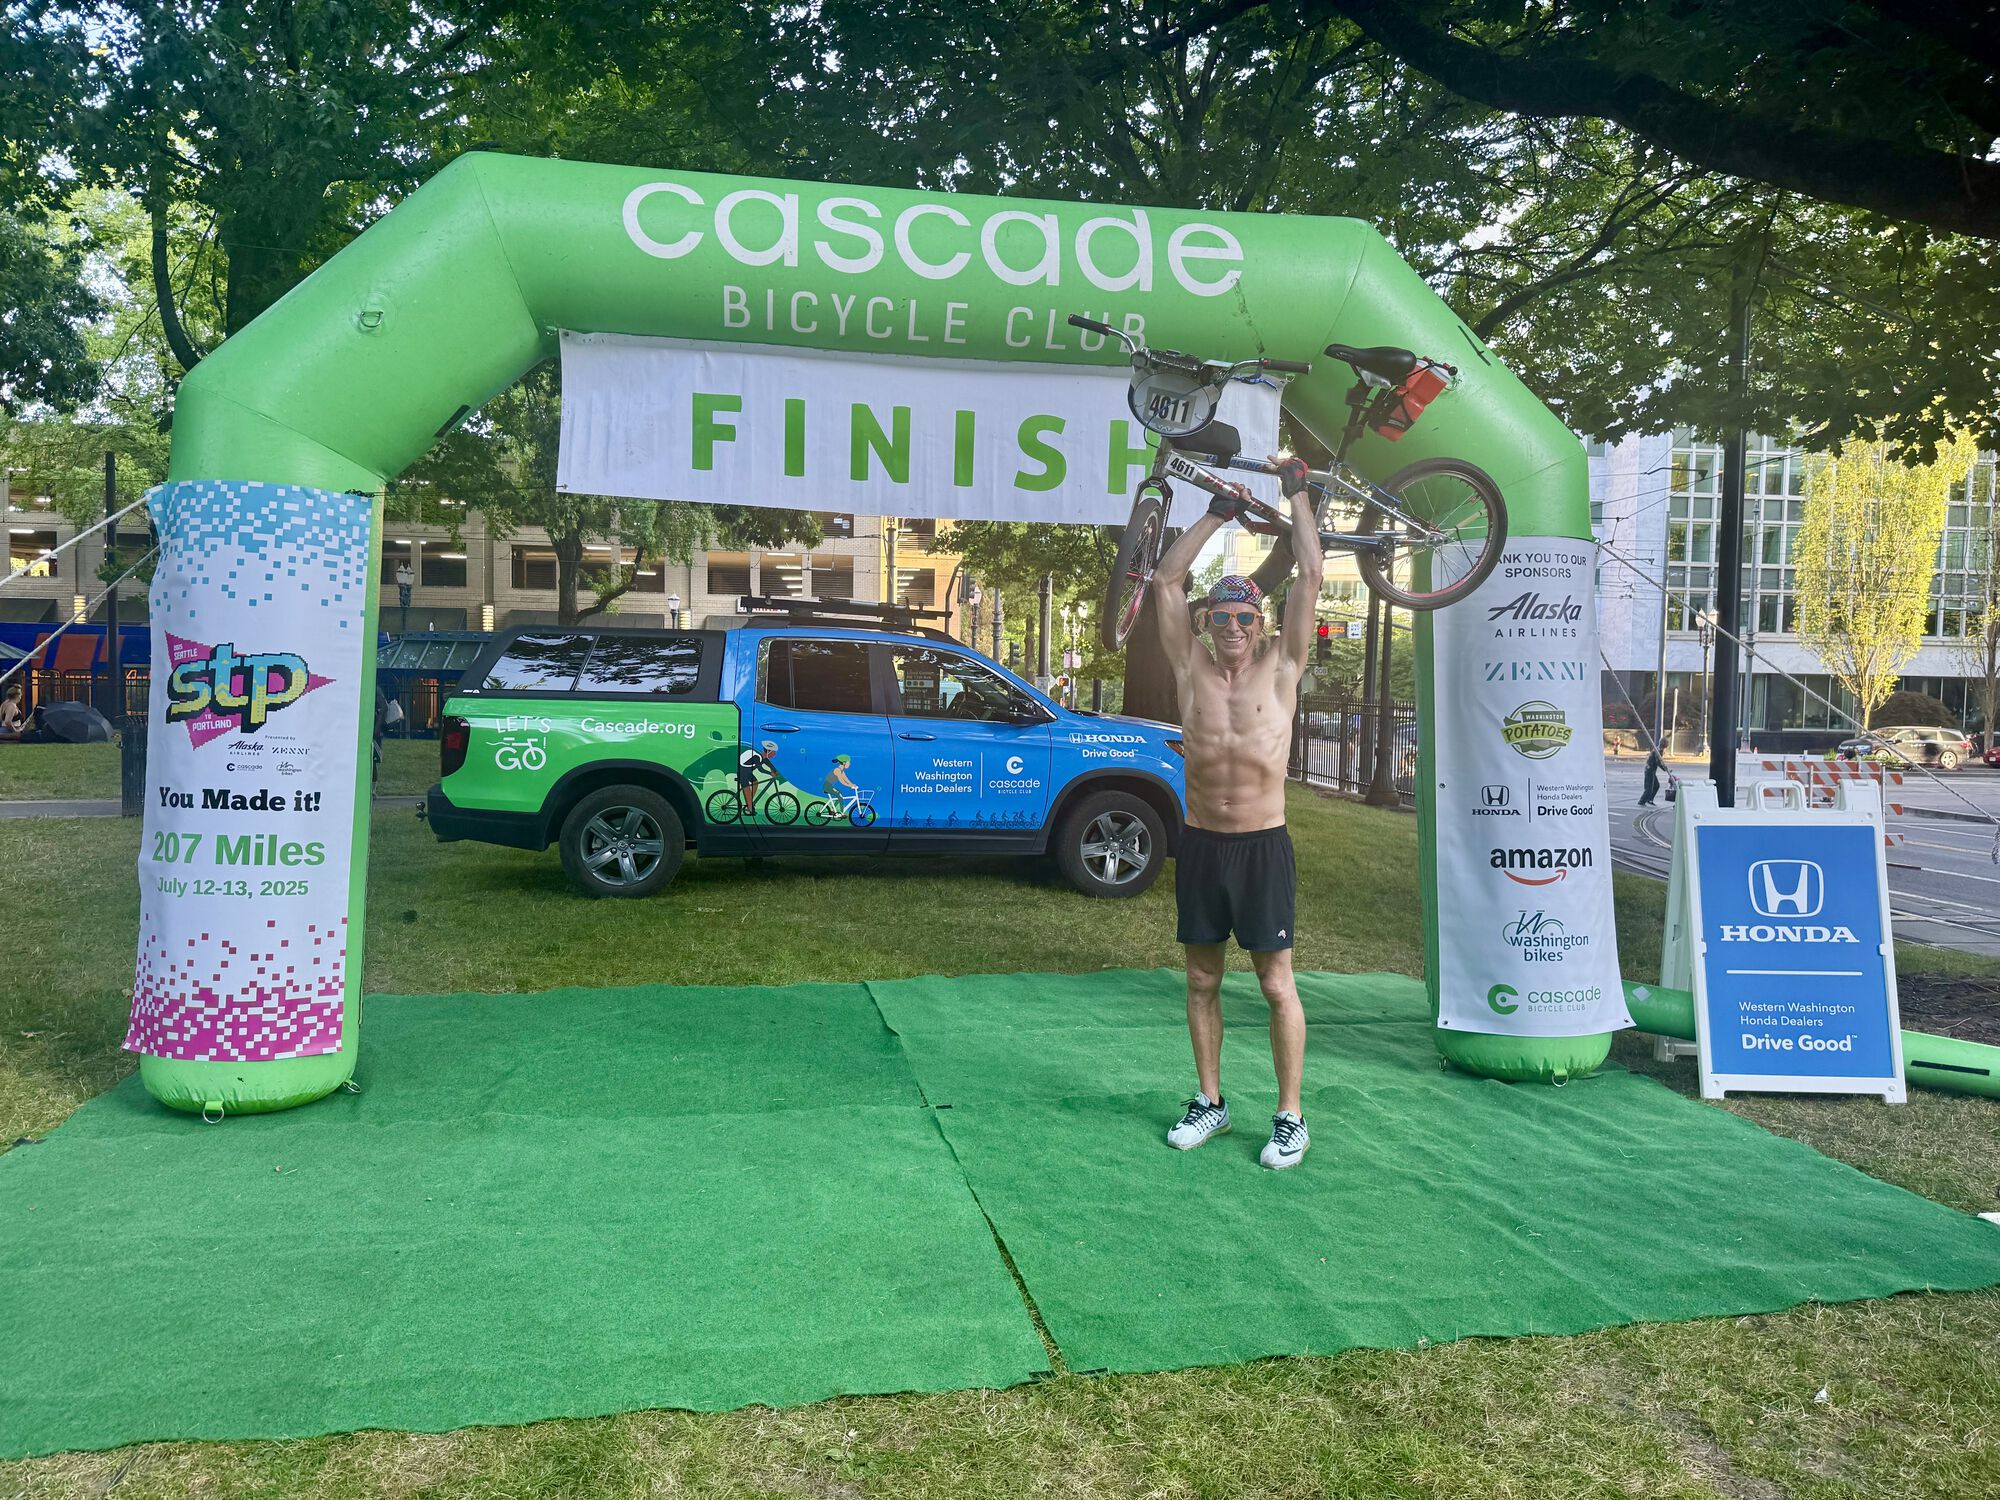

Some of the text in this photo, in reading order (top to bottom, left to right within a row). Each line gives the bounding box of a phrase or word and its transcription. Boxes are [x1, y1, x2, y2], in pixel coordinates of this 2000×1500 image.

[622, 181, 1245, 297] cascade
[722, 284, 1149, 353] BICYCLE CLUB
[691, 392, 1165, 498] FINISH
[1170, 457, 1196, 477] 4611
[1525, 553, 1552, 563] YOU
[1555, 553, 1570, 564] TO
[1571, 555, 1587, 566] OUR
[1504, 567, 1572, 579] SPONSORS
[1487, 591, 1582, 624] Alaska
[1494, 627, 1577, 638] AIRLINES
[173, 648, 198, 661] SEATTLE
[1485, 661, 1587, 682] ZENNI
[192, 719, 232, 732] PORTLAND
[495, 716, 552, 734] LET'S
[580, 717, 696, 739] Cascade.org
[1084, 734, 1148, 744] HONDA
[1504, 723, 1571, 743] POTATOES
[227, 740, 264, 751] Alaska
[1082, 749, 1108, 758] Drive
[932, 757, 974, 767] Western
[914, 770, 973, 783] Washington
[900, 783, 973, 794] Honda Dealers
[988, 778, 1041, 789] cascade
[1536, 784, 1565, 792] Western
[158, 786, 322, 813] You Made it!
[1536, 793, 1583, 801] Honda Dealers
[1471, 808, 1522, 816] HONDA
[1537, 805, 1568, 816] Drive
[151, 830, 326, 866] 207 Miles
[1489, 847, 1593, 869] amazon
[156, 876, 310, 899] July 12-13, 2025
[1719, 925, 1860, 943] HONDA
[1509, 932, 1589, 950] washington
[1523, 949, 1564, 962] bikes
[1527, 985, 1602, 1004] cascade
[1527, 1003, 1587, 1012] BICYCLE CLUB
[1738, 1001, 1856, 1016] Western Washington
[1739, 1015, 1824, 1027] Honda Dealers
[1741, 1033, 1794, 1051] Drive
